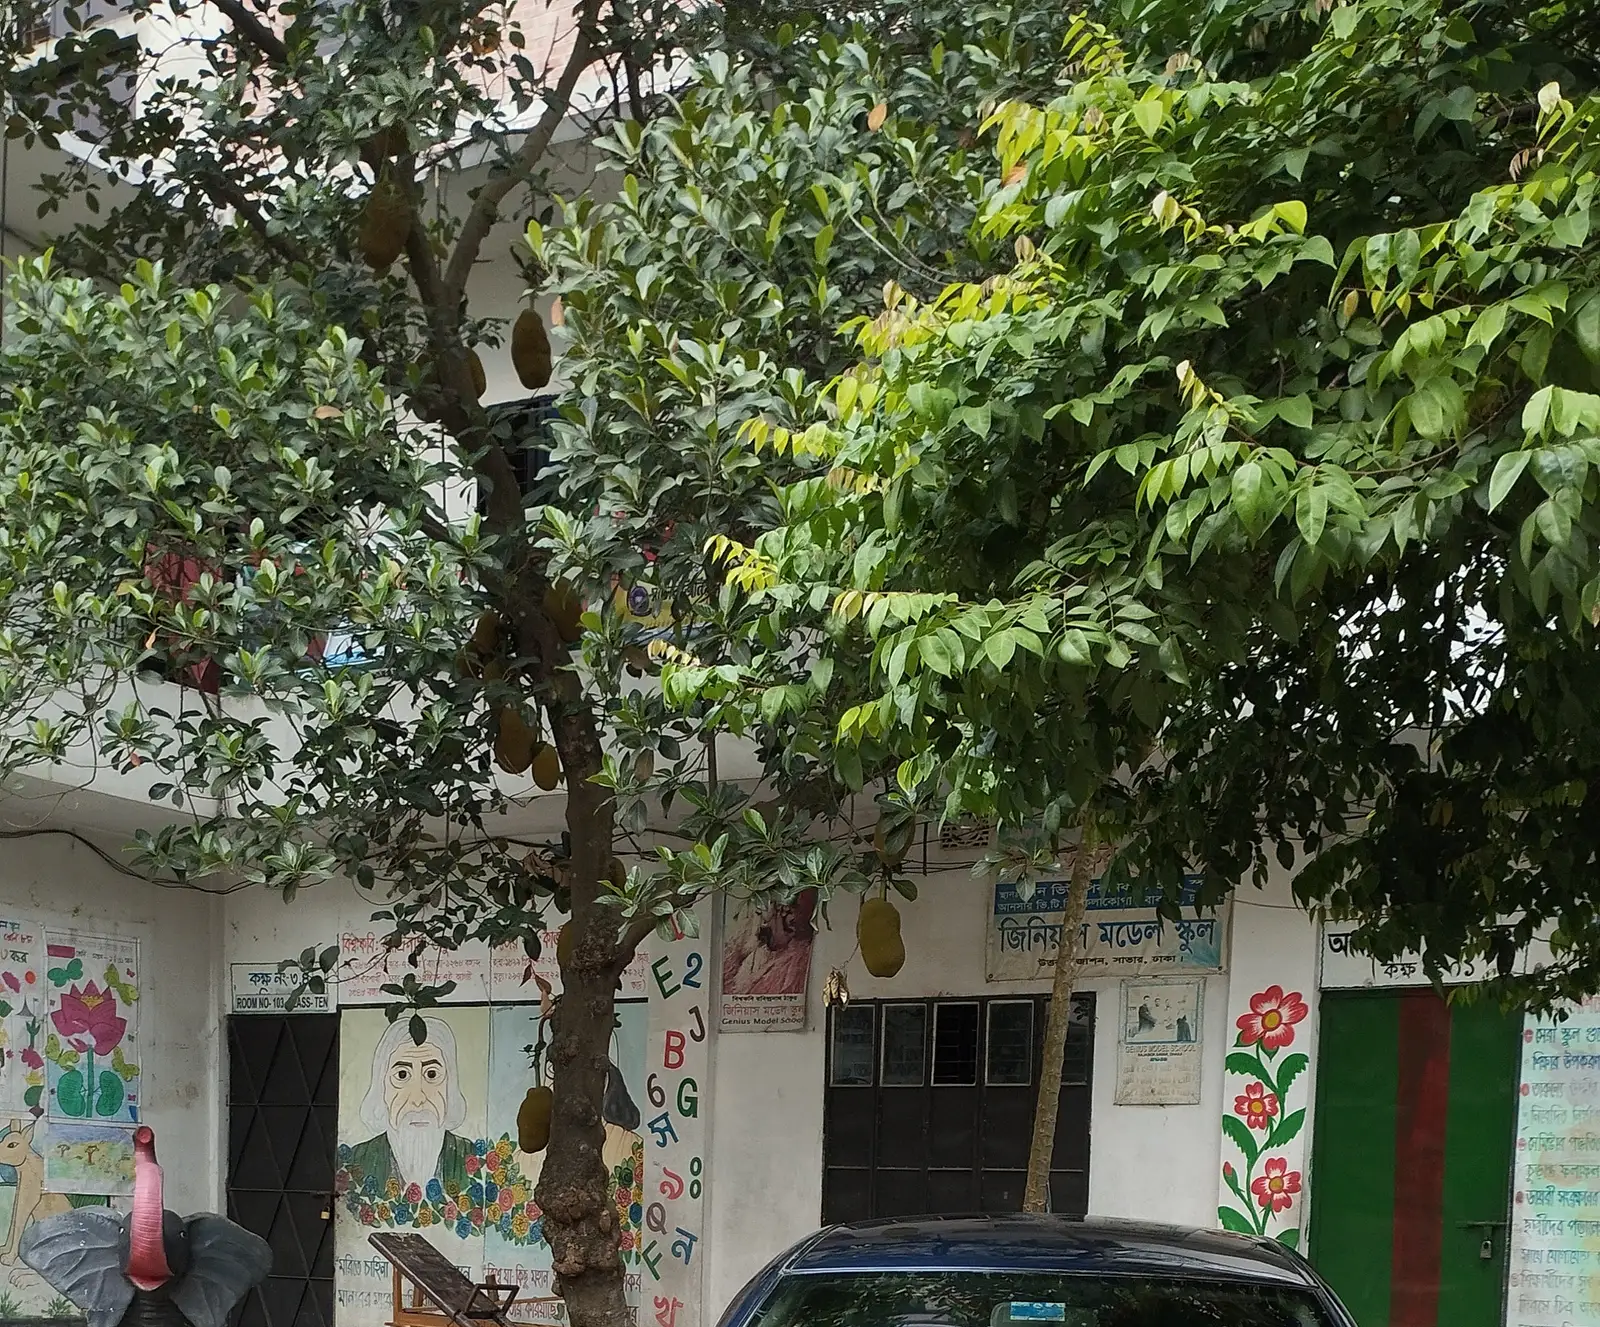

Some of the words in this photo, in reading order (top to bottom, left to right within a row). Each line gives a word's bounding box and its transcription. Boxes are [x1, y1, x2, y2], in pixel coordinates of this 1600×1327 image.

[1097, 920, 1163, 949] মডেল
[1175, 918, 1218, 955] স্কুল
[651, 955, 682, 1000] E
[682, 952, 704, 989] 2
[1112, 955, 1148, 965] সাভার,
[1152, 954, 1177, 963] ঢাকা
[1381, 962, 1418, 979] কক্ষ
[248, 972, 272, 987] কক্ষ
[236, 997, 257, 1009] ROOM
[273, 997, 285, 1009] 103
[314, 996, 328, 1008] TEN
[723, 1003, 761, 1017] জিনিয়াস
[763, 1005, 788, 1017] মডেল
[753, 1017, 779, 1025] Model
[780, 1016, 804, 1024] School
[688, 1005, 706, 1043] J
[663, 1030, 686, 1069] B
[677, 1077, 698, 1118] G
[647, 1112, 679, 1148] স
[646, 1202, 668, 1235] Q
[641, 1239, 663, 1281] F
[671, 1227, 699, 1265] ন
